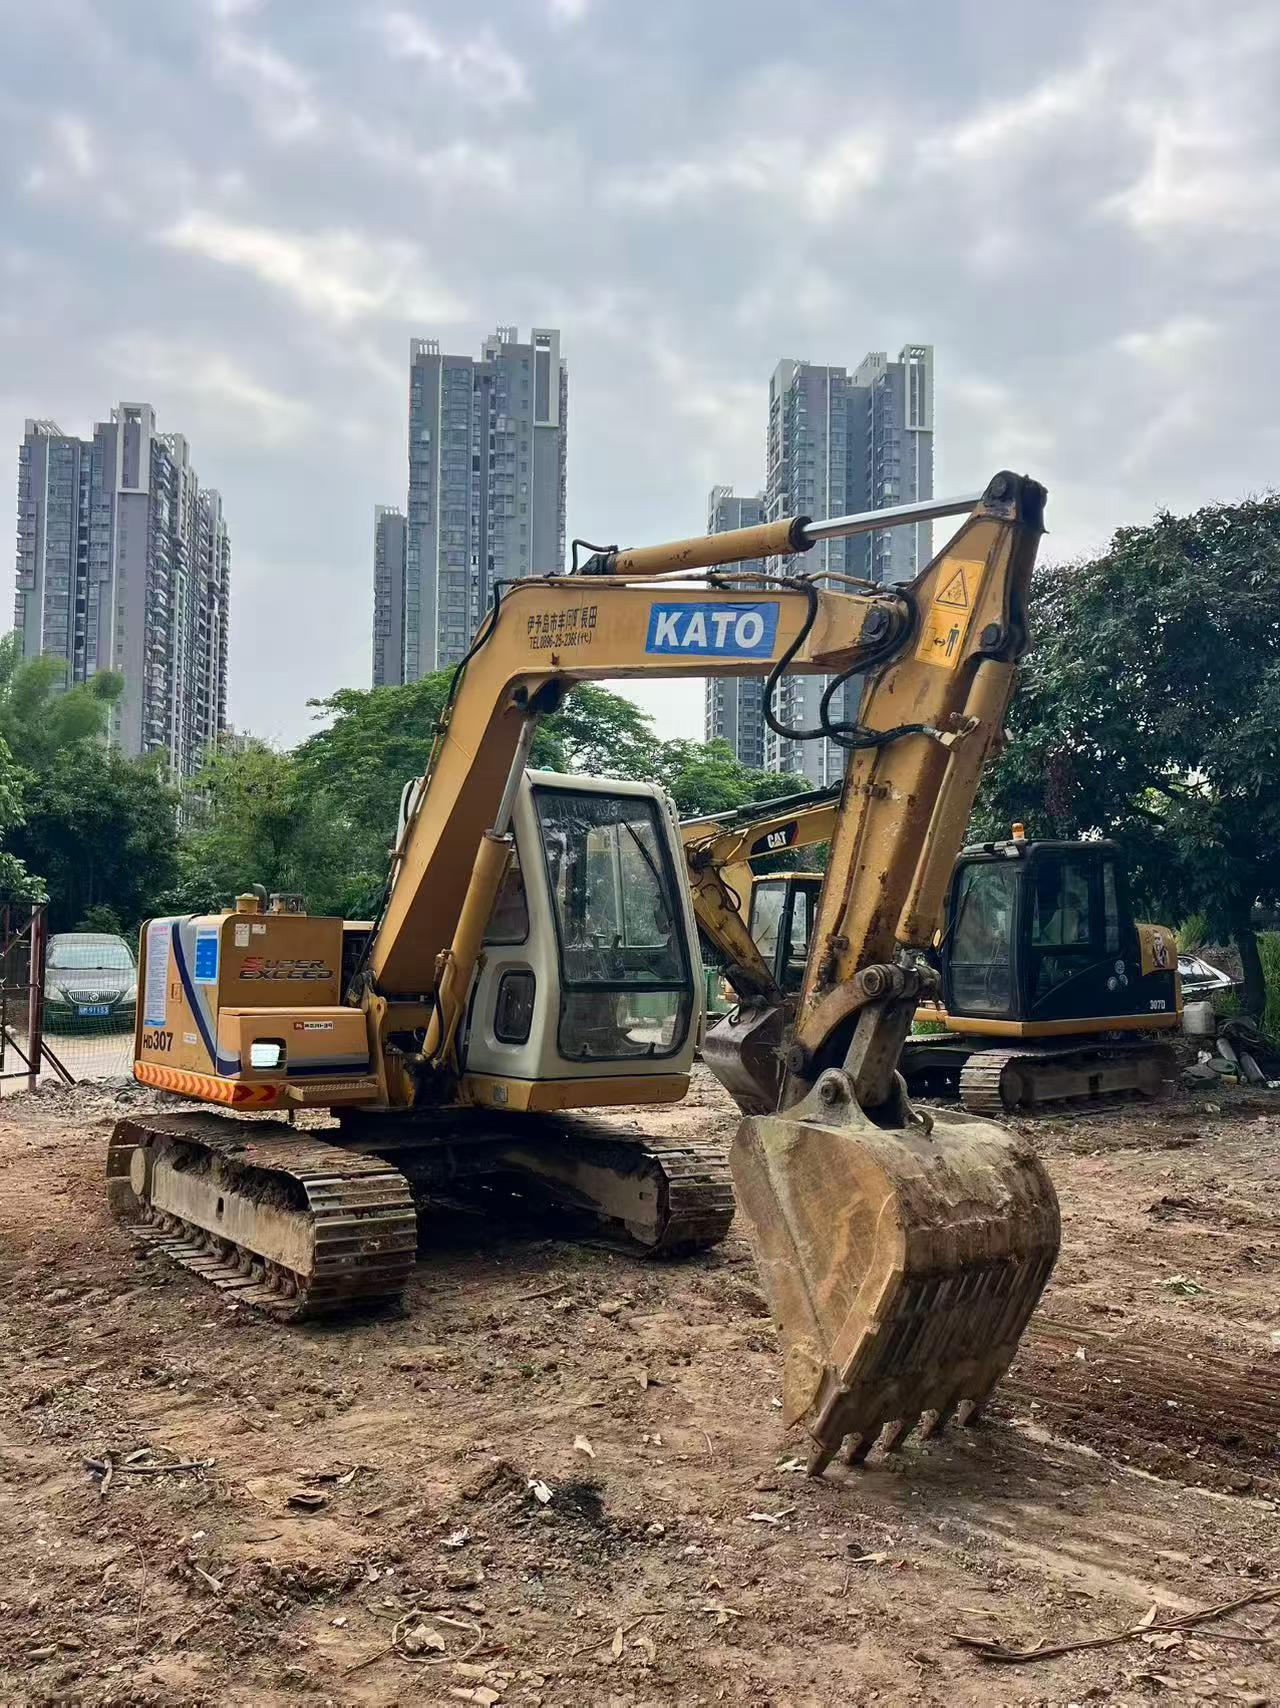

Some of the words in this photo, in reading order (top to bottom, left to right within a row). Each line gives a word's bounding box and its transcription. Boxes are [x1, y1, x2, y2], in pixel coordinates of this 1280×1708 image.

[654, 611, 764, 649] KATO
[767, 831, 787, 848] CAT
[240, 957, 325, 972] SUPER
[239, 970, 334, 981] EXCEED
[1149, 1000, 1166, 1010] 307D
[143, 1030, 173, 1052] HD307
